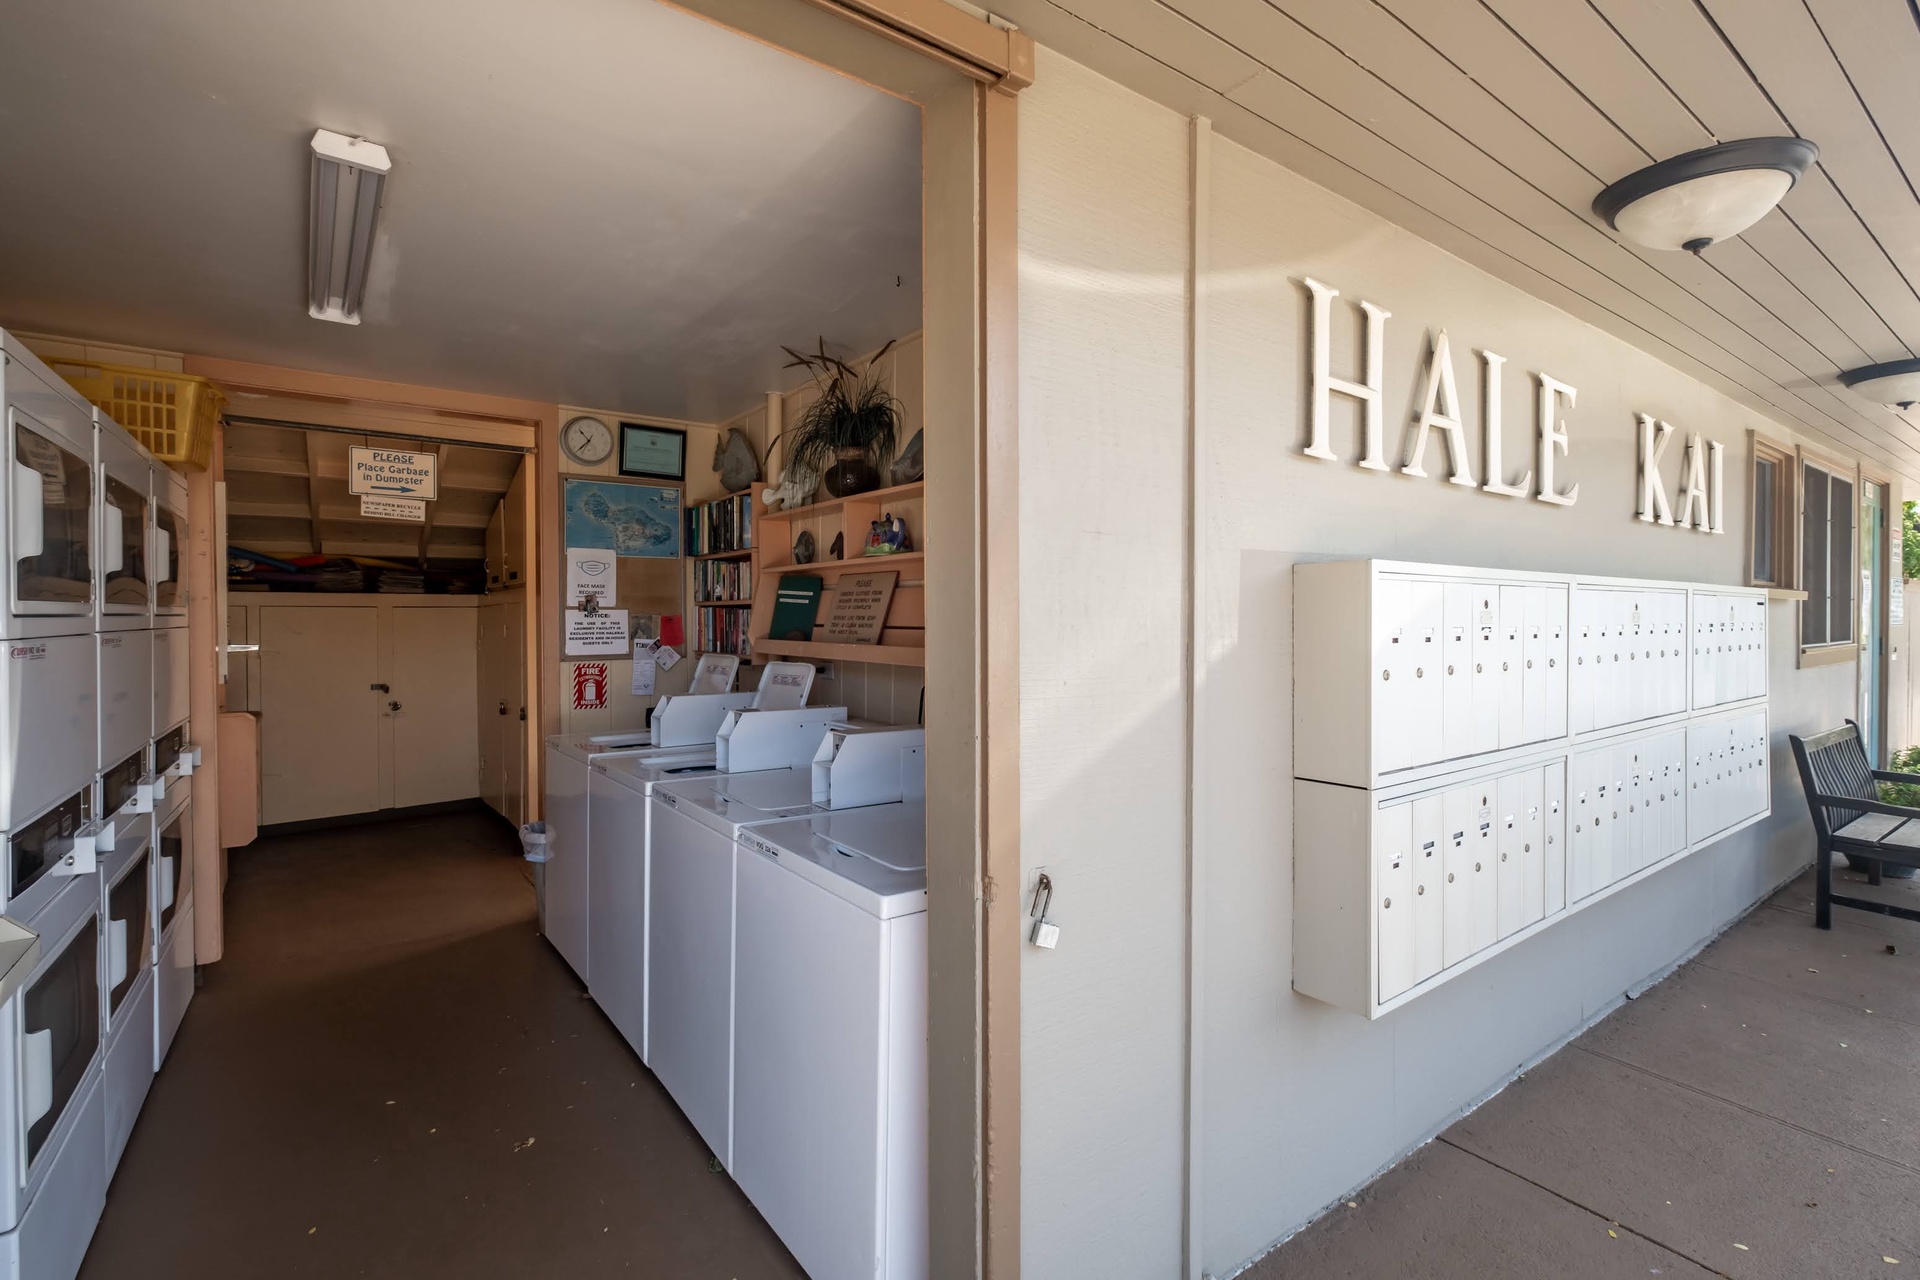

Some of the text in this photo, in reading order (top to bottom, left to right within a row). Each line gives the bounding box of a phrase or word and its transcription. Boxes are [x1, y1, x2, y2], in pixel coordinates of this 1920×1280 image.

[1303, 276, 1725, 535] HALE KAI
[373, 452, 414, 464] PLEASE
[357, 462, 429, 476] Place Garbage
[363, 473, 424, 485] in Dumpster
[581, 667, 600, 675] FIRE
